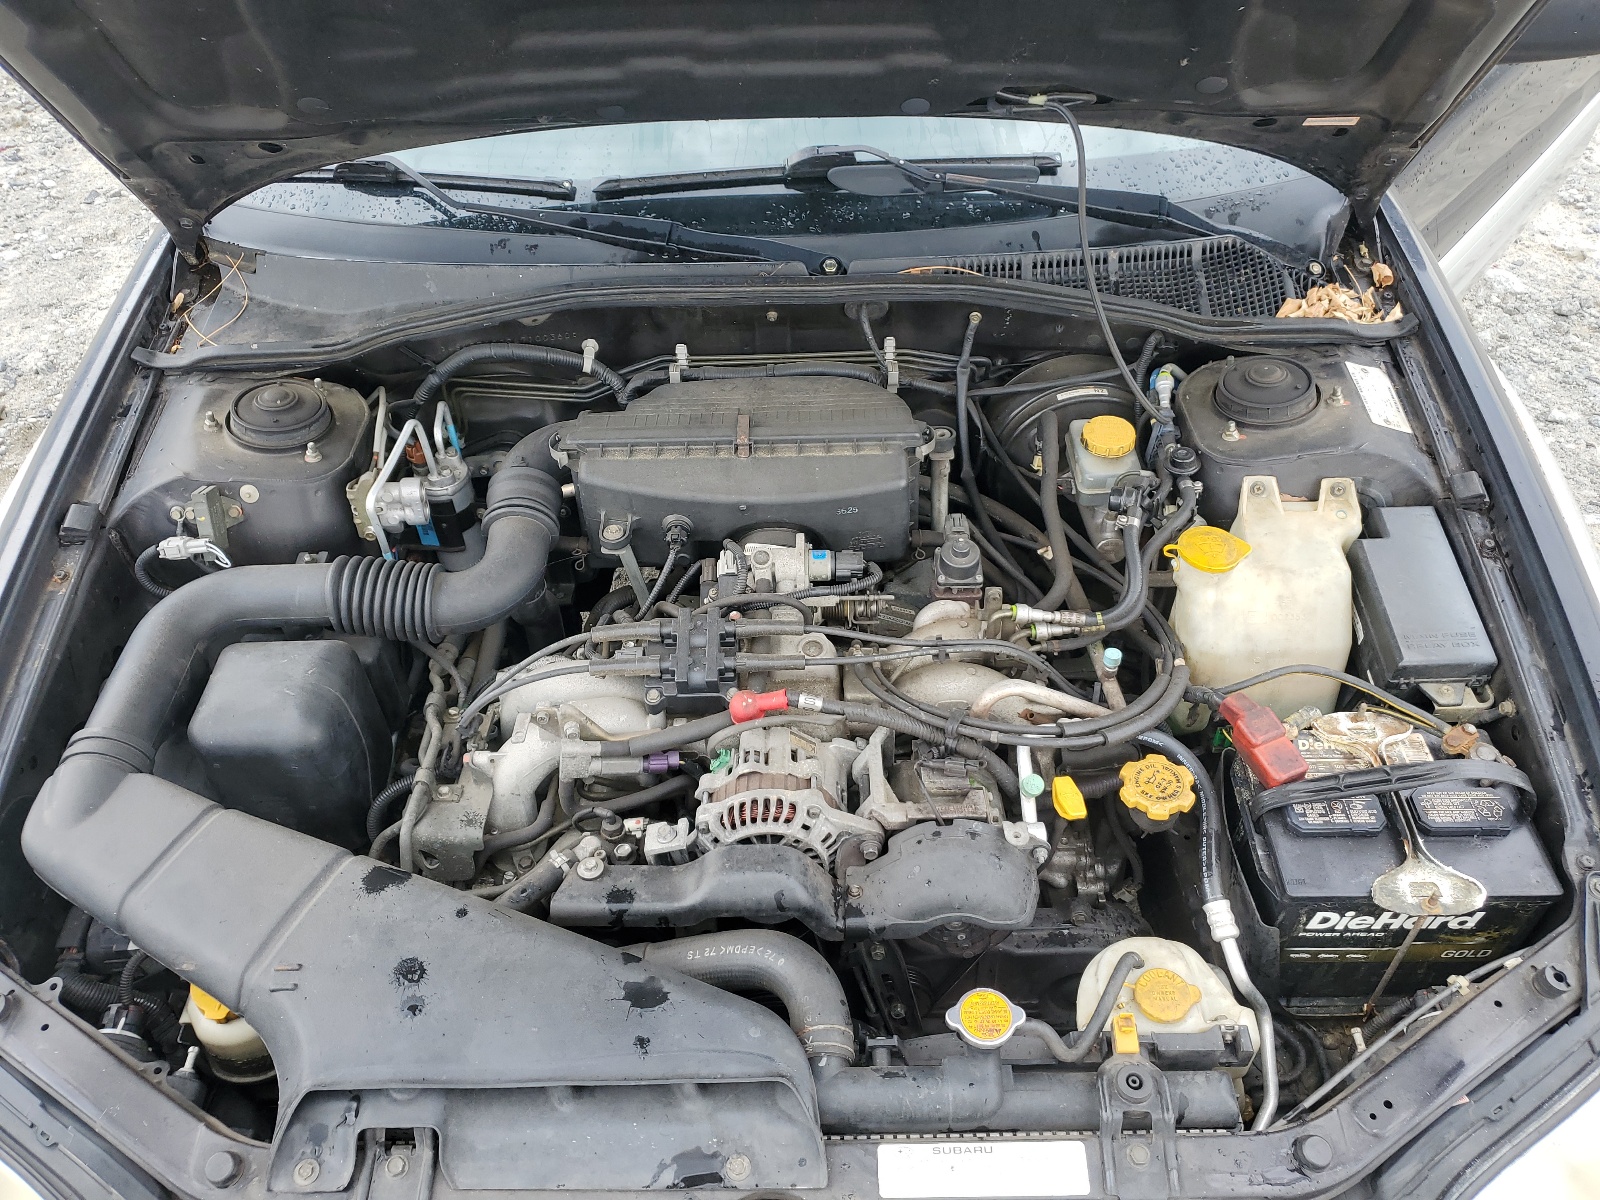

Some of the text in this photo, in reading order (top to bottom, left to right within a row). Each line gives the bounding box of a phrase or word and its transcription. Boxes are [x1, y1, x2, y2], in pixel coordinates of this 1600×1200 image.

[1305, 911, 1487, 930] DieHard
[1440, 949, 1493, 958] GOLD
[1137, 969, 1185, 989] COOLANT
[932, 1146, 993, 1155] SUBARU
